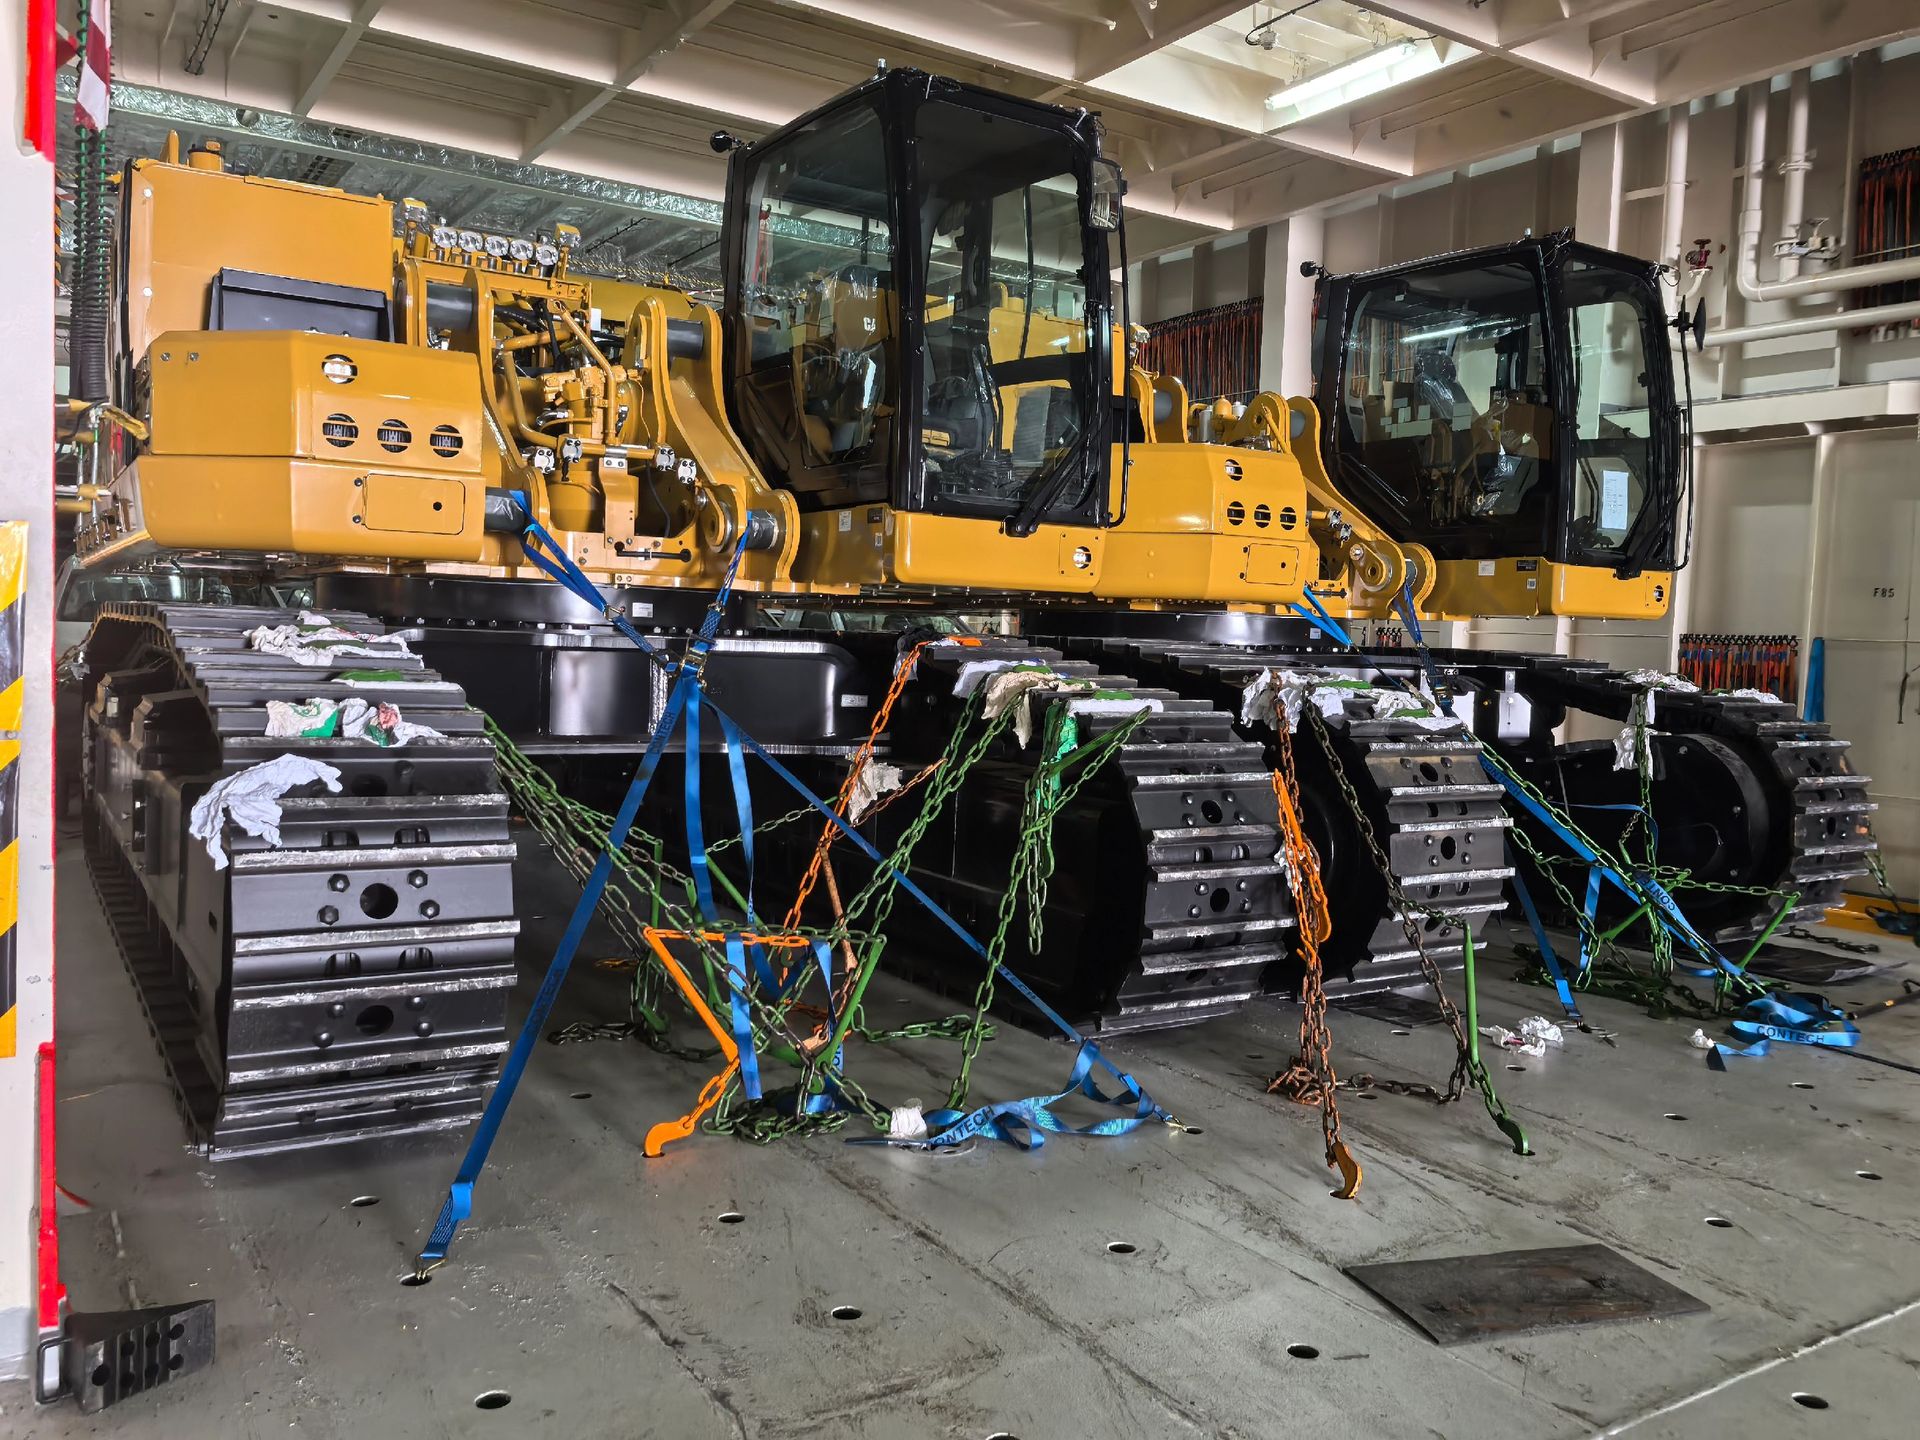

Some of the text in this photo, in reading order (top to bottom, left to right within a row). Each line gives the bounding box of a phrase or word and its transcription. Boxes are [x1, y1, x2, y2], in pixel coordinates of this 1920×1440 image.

[1873, 587, 1895, 598] F85
[1757, 1025, 1825, 1043] CONTECH
[934, 1105, 995, 1144] ONTECH
